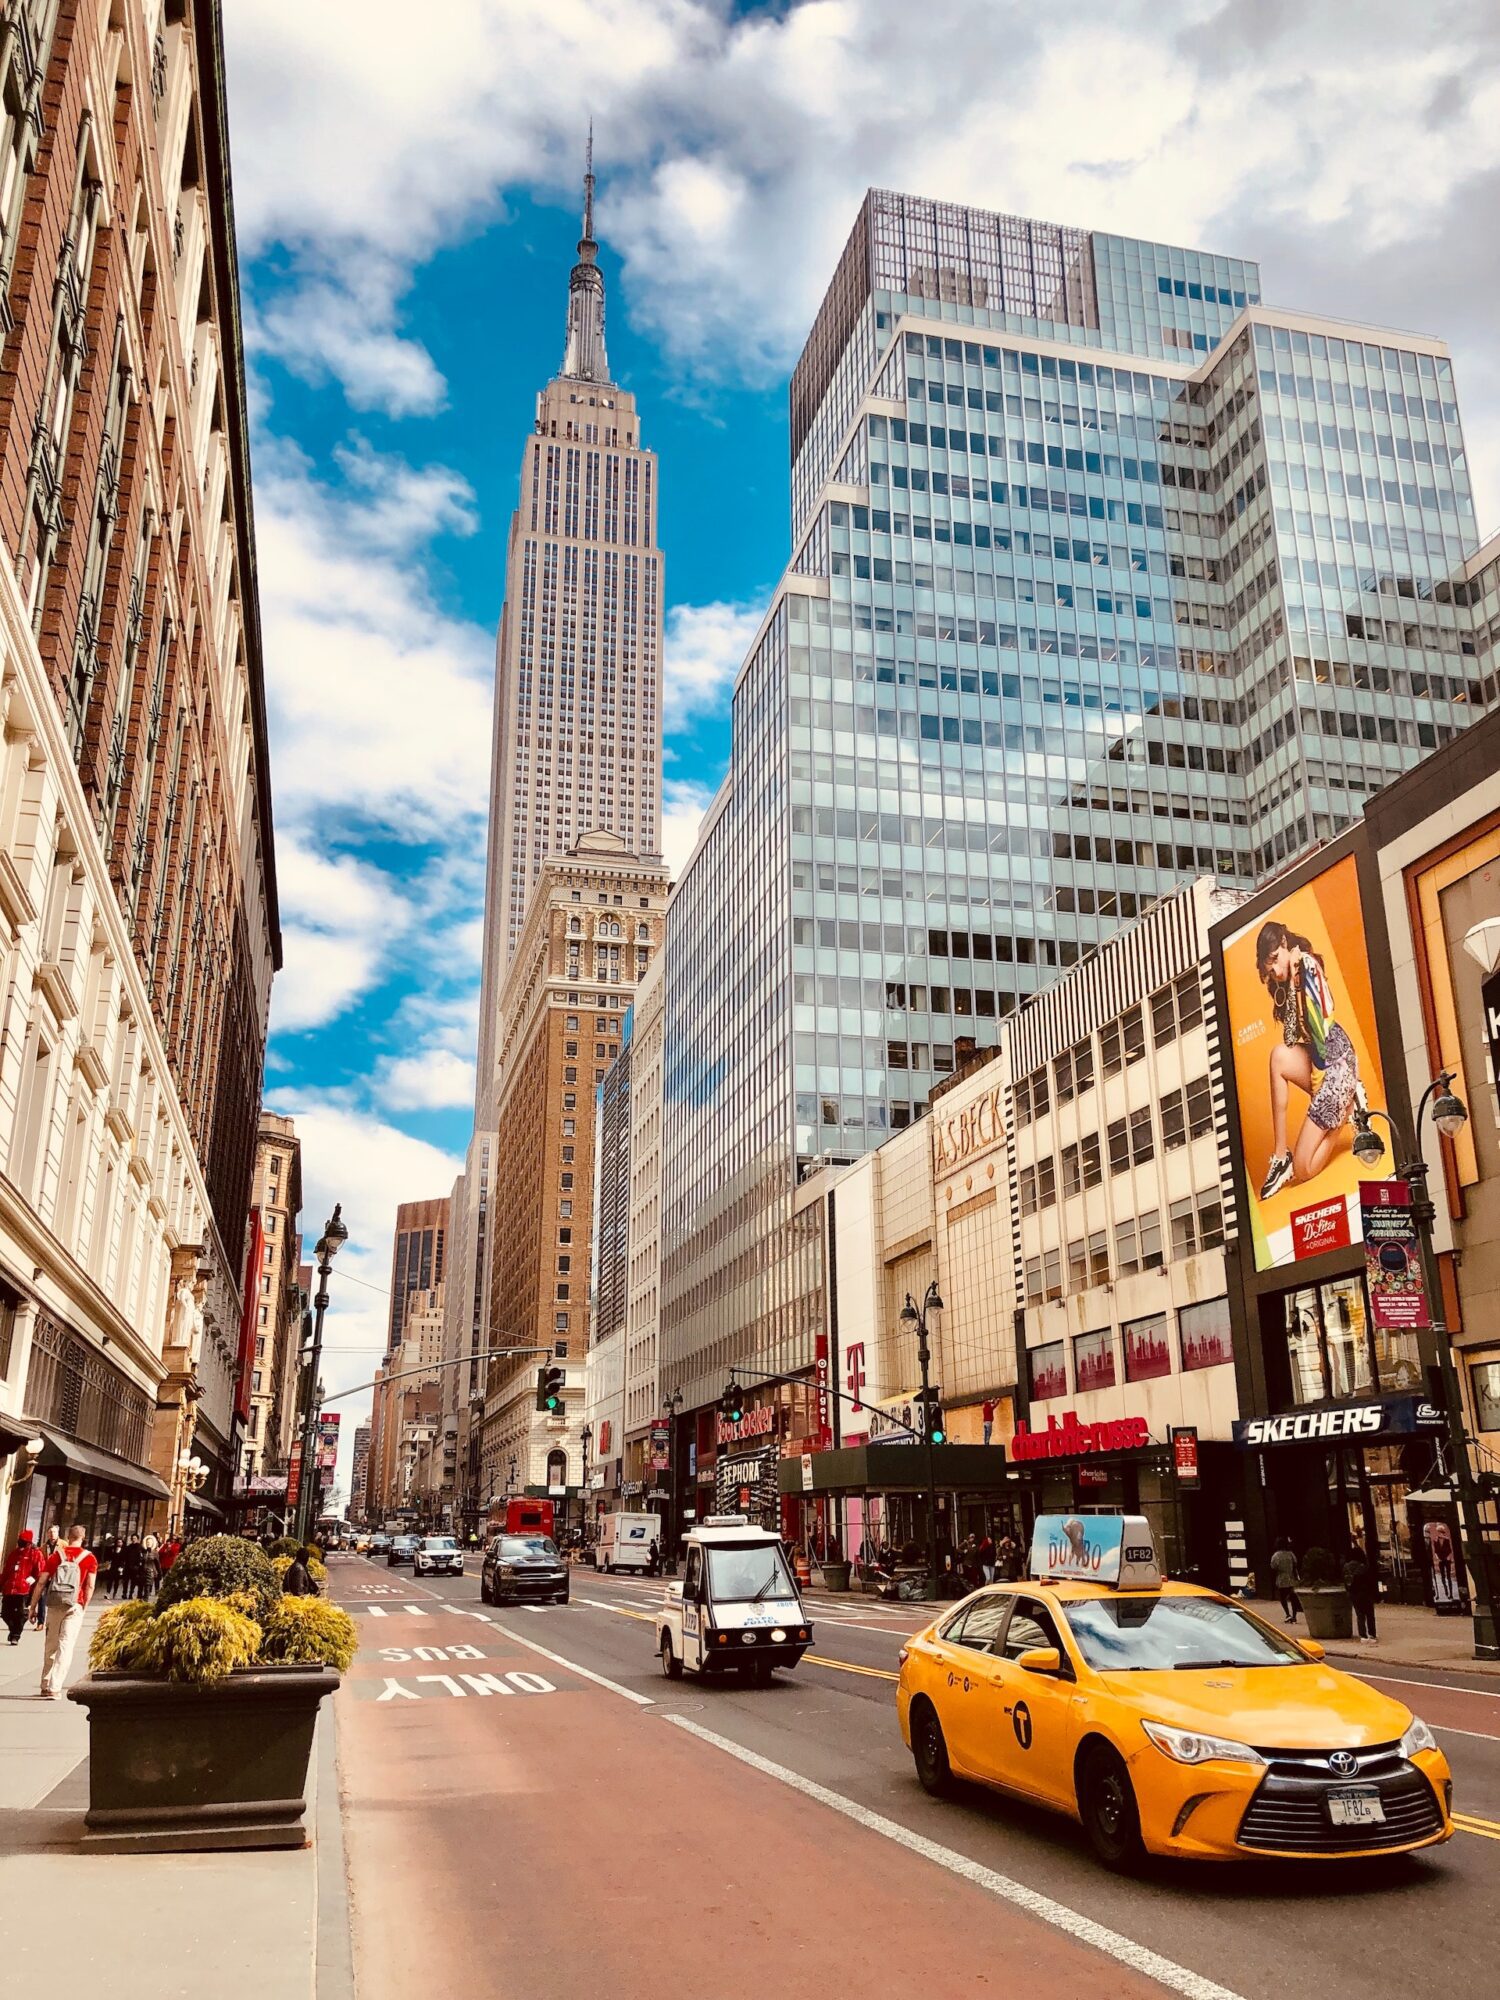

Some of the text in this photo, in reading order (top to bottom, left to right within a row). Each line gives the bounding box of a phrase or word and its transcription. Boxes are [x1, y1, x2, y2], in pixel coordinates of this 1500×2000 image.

[1239, 1019, 1264, 1037] CAMILA
[1295, 1203, 1342, 1226] SKECHERS
[1371, 1220, 1406, 1228] JOURNEY
[1248, 1405, 1382, 1444] SKECHERS
[1012, 1411, 1149, 1460] charlotte russe
[723, 1461, 761, 1487] SEPHORA
[1128, 1549, 1151, 1559] 1F82
[743, 1618, 780, 1626] POLICE
[378, 1644, 489, 1662] BUS
[376, 1671, 557, 1701] ONLY
